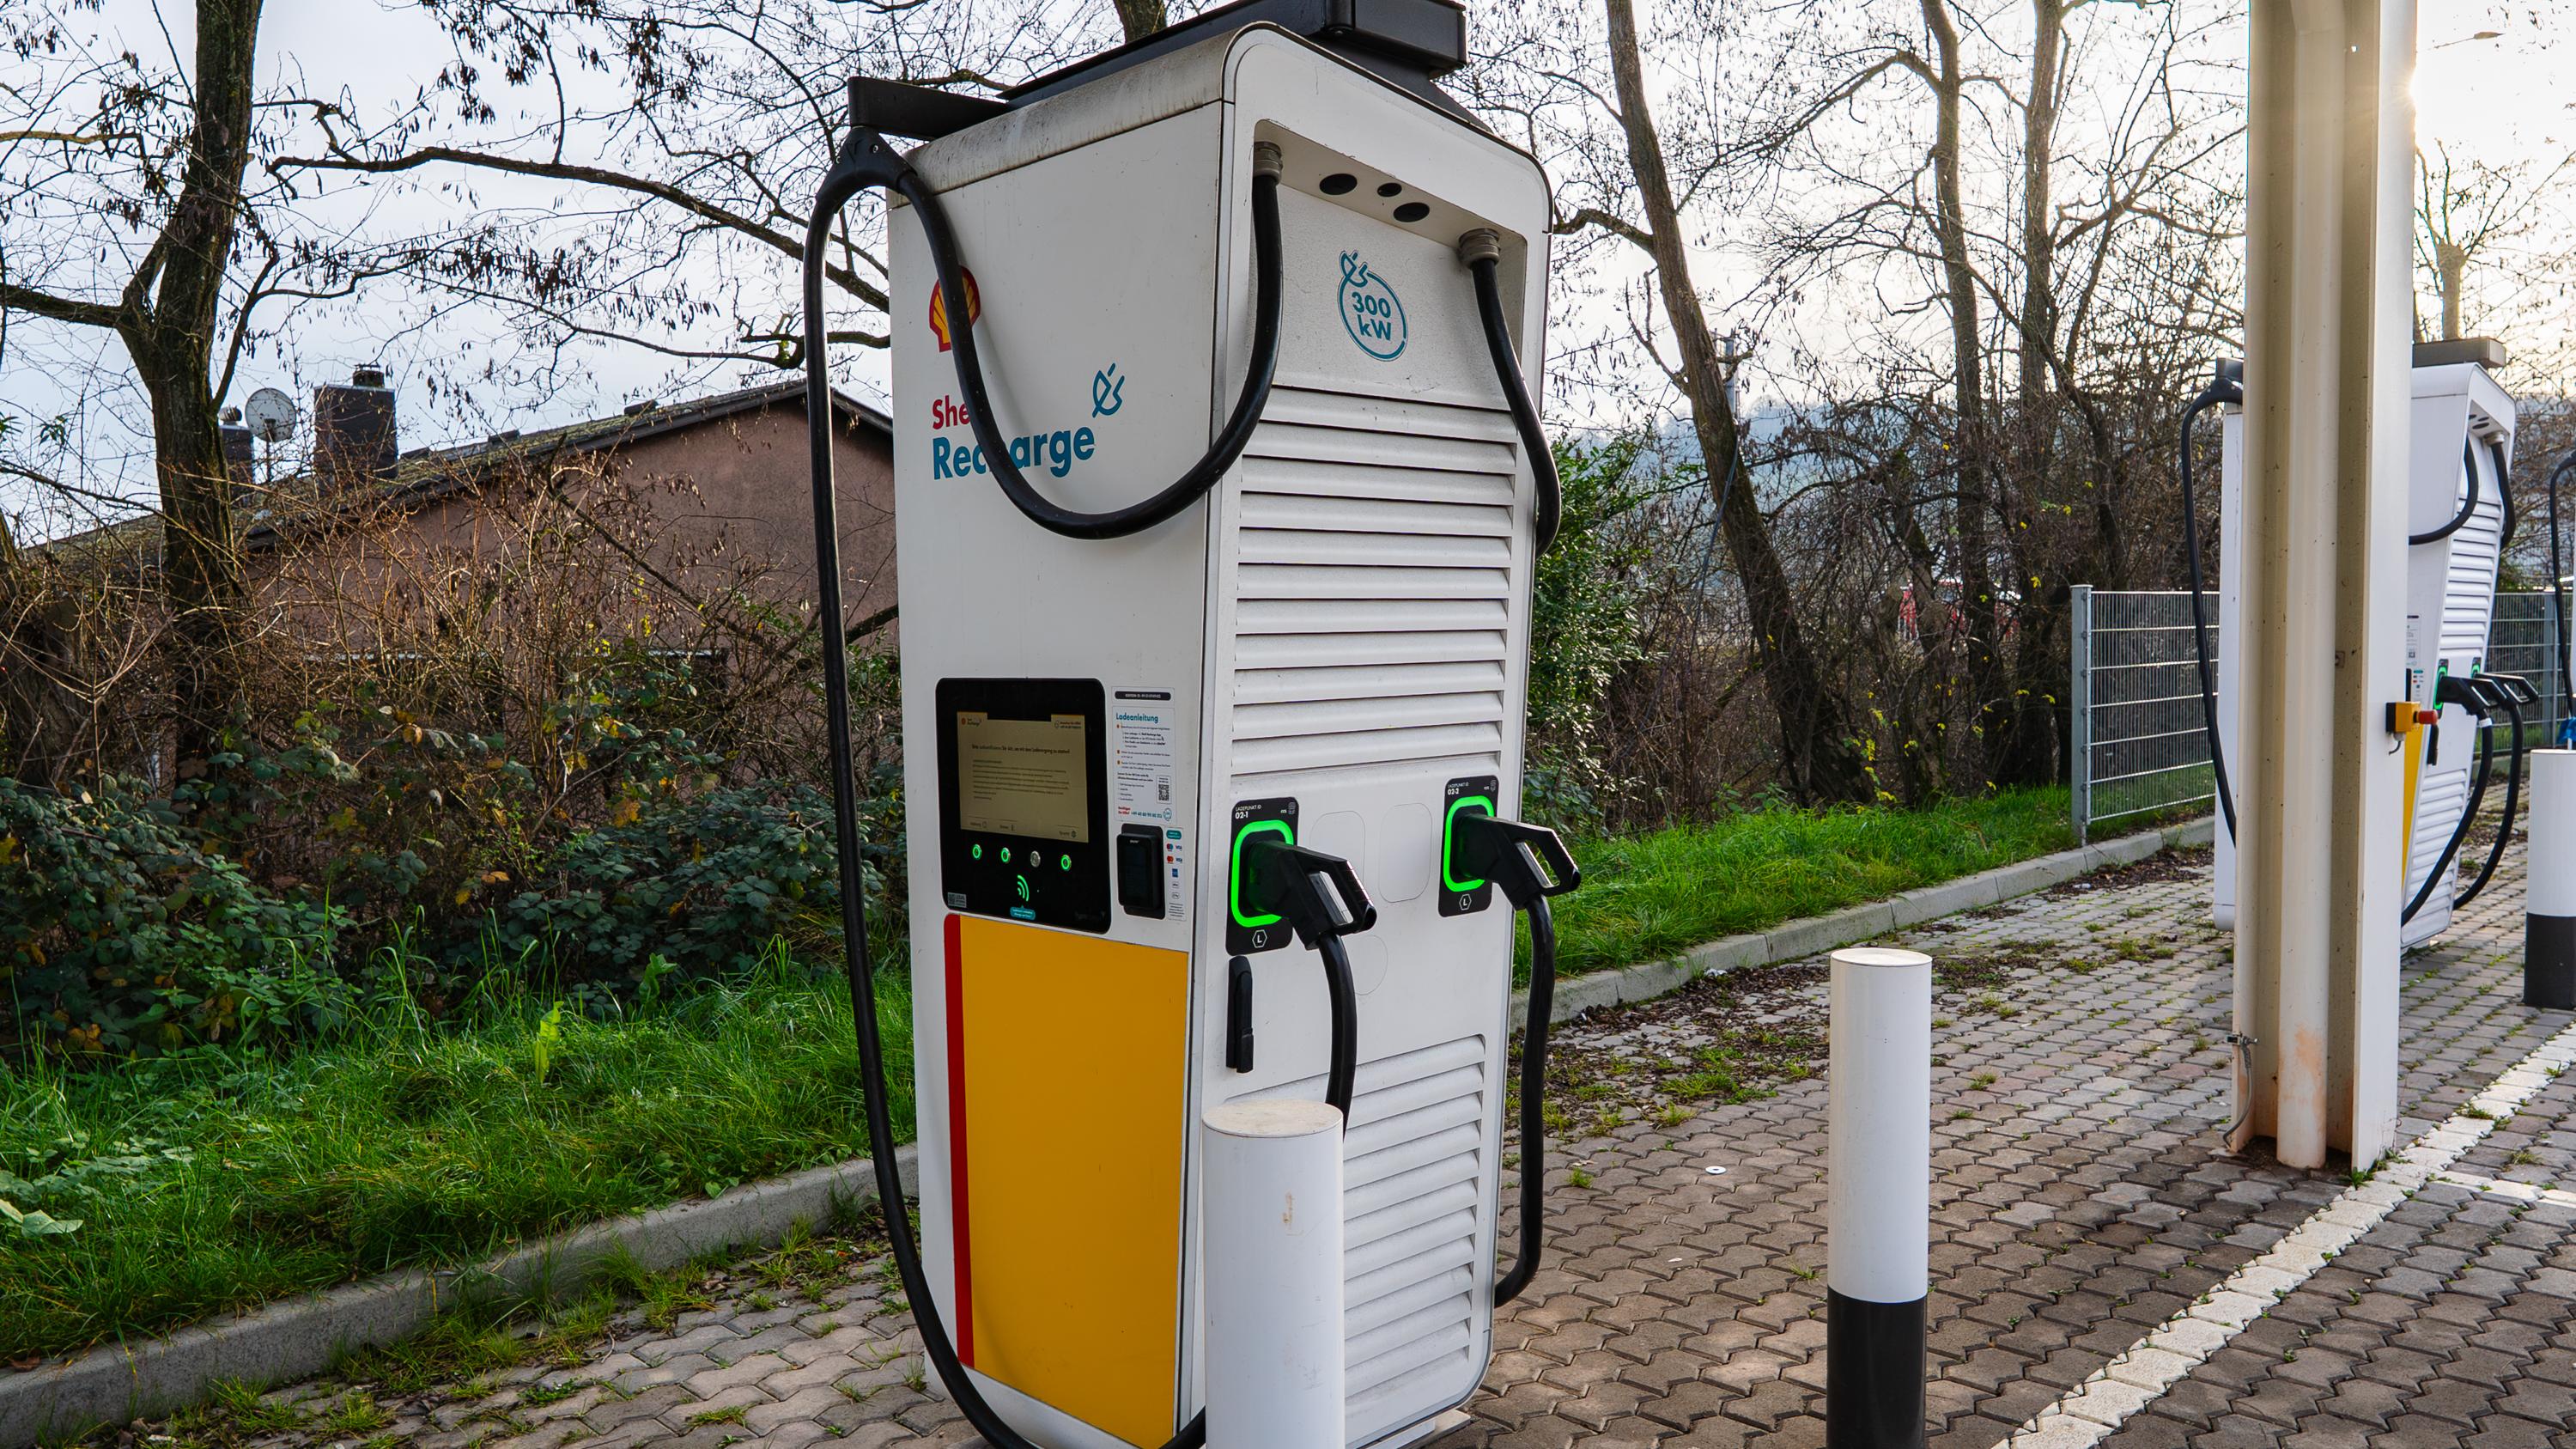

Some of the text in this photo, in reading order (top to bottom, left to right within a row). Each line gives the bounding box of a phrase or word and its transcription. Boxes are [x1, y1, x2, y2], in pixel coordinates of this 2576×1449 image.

[1352, 291, 1391, 319] 300
[1357, 314, 1392, 341] kW
[932, 395, 971, 430] She
[933, 425, 1096, 480] Recarge
[1115, 712, 1158, 724] Ladeanleitung
[1235, 811, 1249, 819] 02-1
[1256, 935, 1263, 944] L
